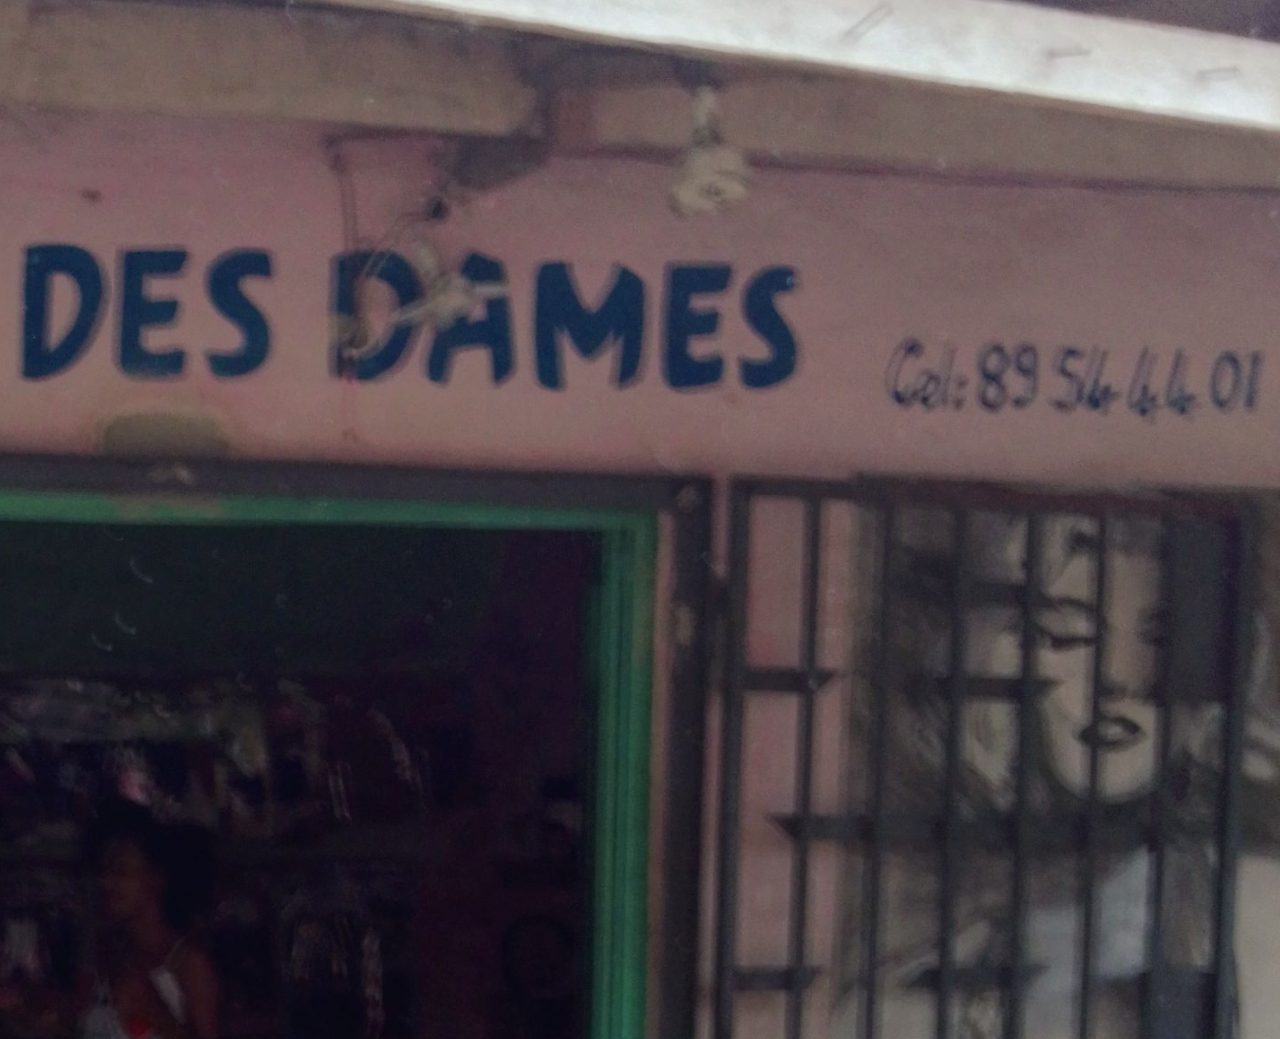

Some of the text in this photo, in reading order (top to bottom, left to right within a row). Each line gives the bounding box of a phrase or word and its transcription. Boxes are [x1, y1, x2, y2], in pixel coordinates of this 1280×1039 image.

[21, 243, 272, 382] DES
[329, 250, 804, 392] DAMES
[977, 342, 1039, 412] 89
[1048, 345, 1120, 413] 54
[1127, 345, 1196, 420] 44
[1209, 349, 1262, 410] 01
